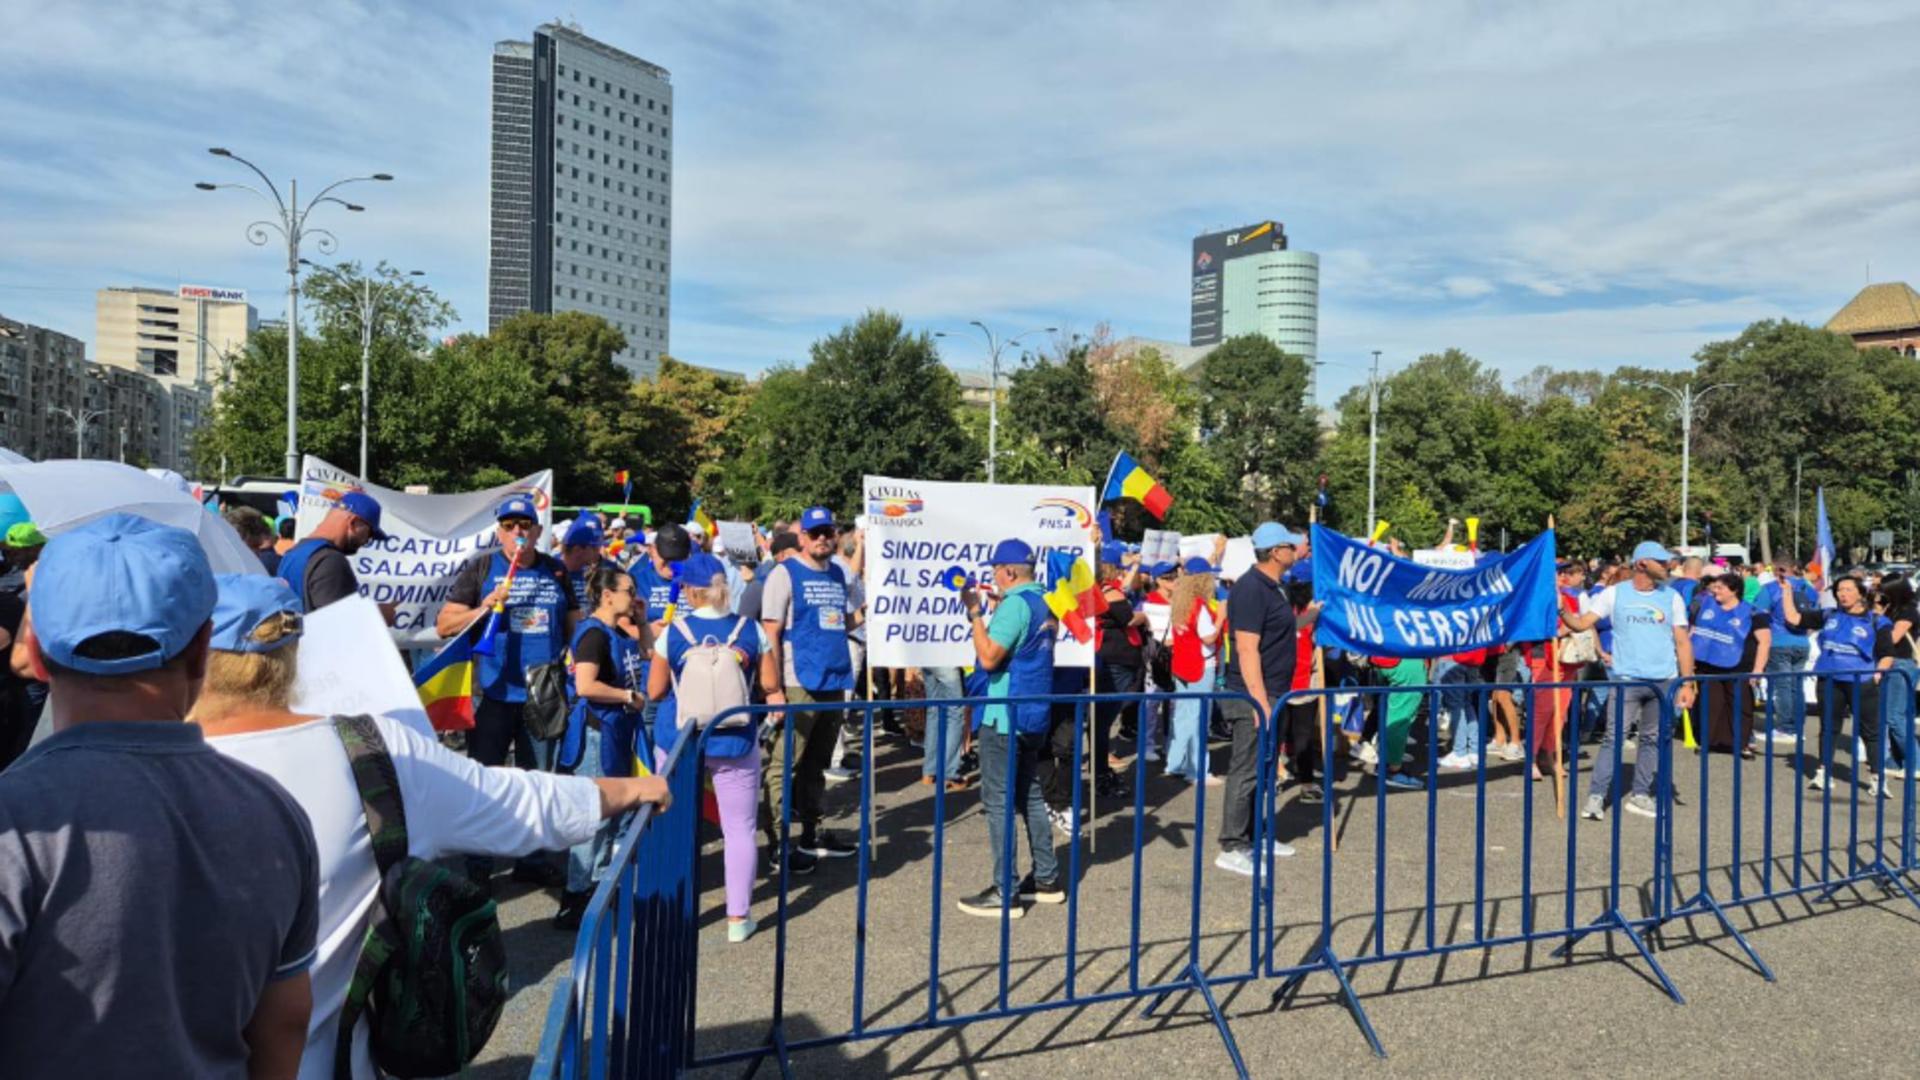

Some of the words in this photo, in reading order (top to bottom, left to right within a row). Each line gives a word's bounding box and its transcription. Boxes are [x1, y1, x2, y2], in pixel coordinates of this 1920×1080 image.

[1226, 233, 1240, 247] EY
[356, 556, 467, 578] SALARIA
[1337, 546, 1396, 597] NOI
[882, 568, 911, 588] AL
[873, 595, 912, 615] DIN
[1344, 599, 1384, 645] NU
